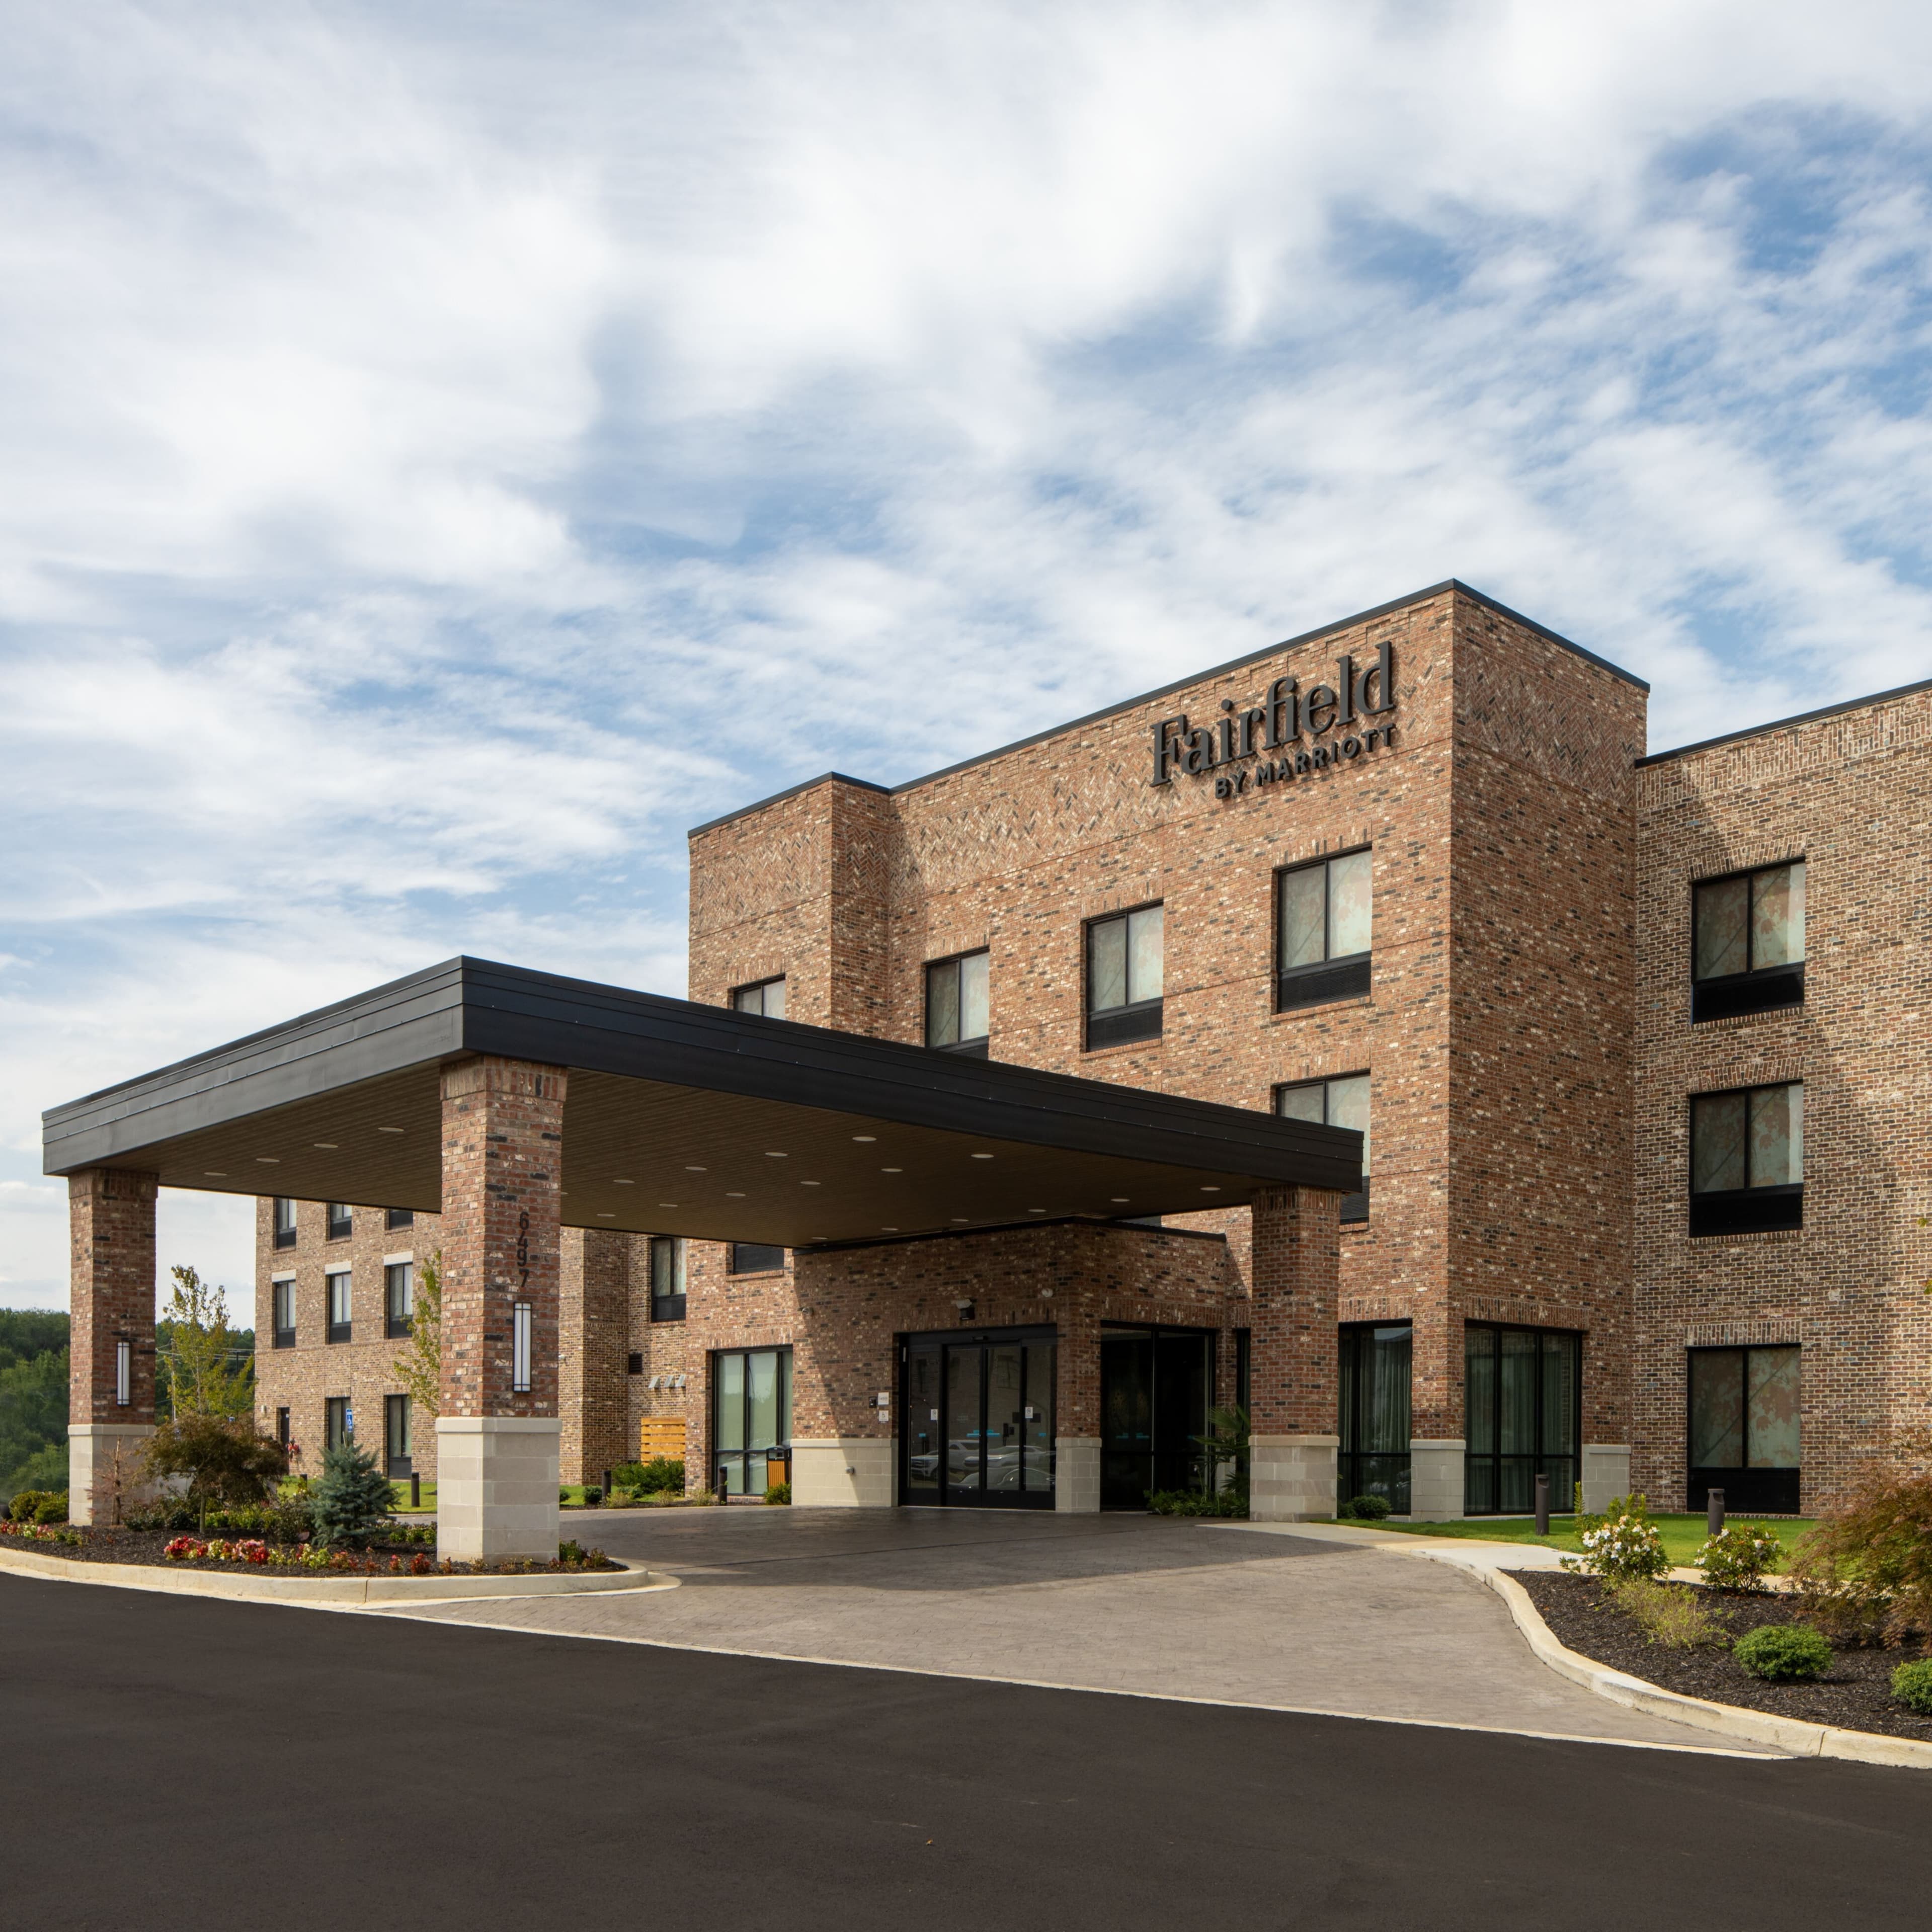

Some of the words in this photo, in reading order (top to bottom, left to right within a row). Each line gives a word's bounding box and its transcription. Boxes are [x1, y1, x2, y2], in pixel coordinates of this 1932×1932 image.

[1150, 640, 1396, 787] Fairfield
[1215, 770, 1247, 799] BY
[1256, 723, 1396, 786] MARRIOTT
[517, 1211, 529, 1287] 6497
